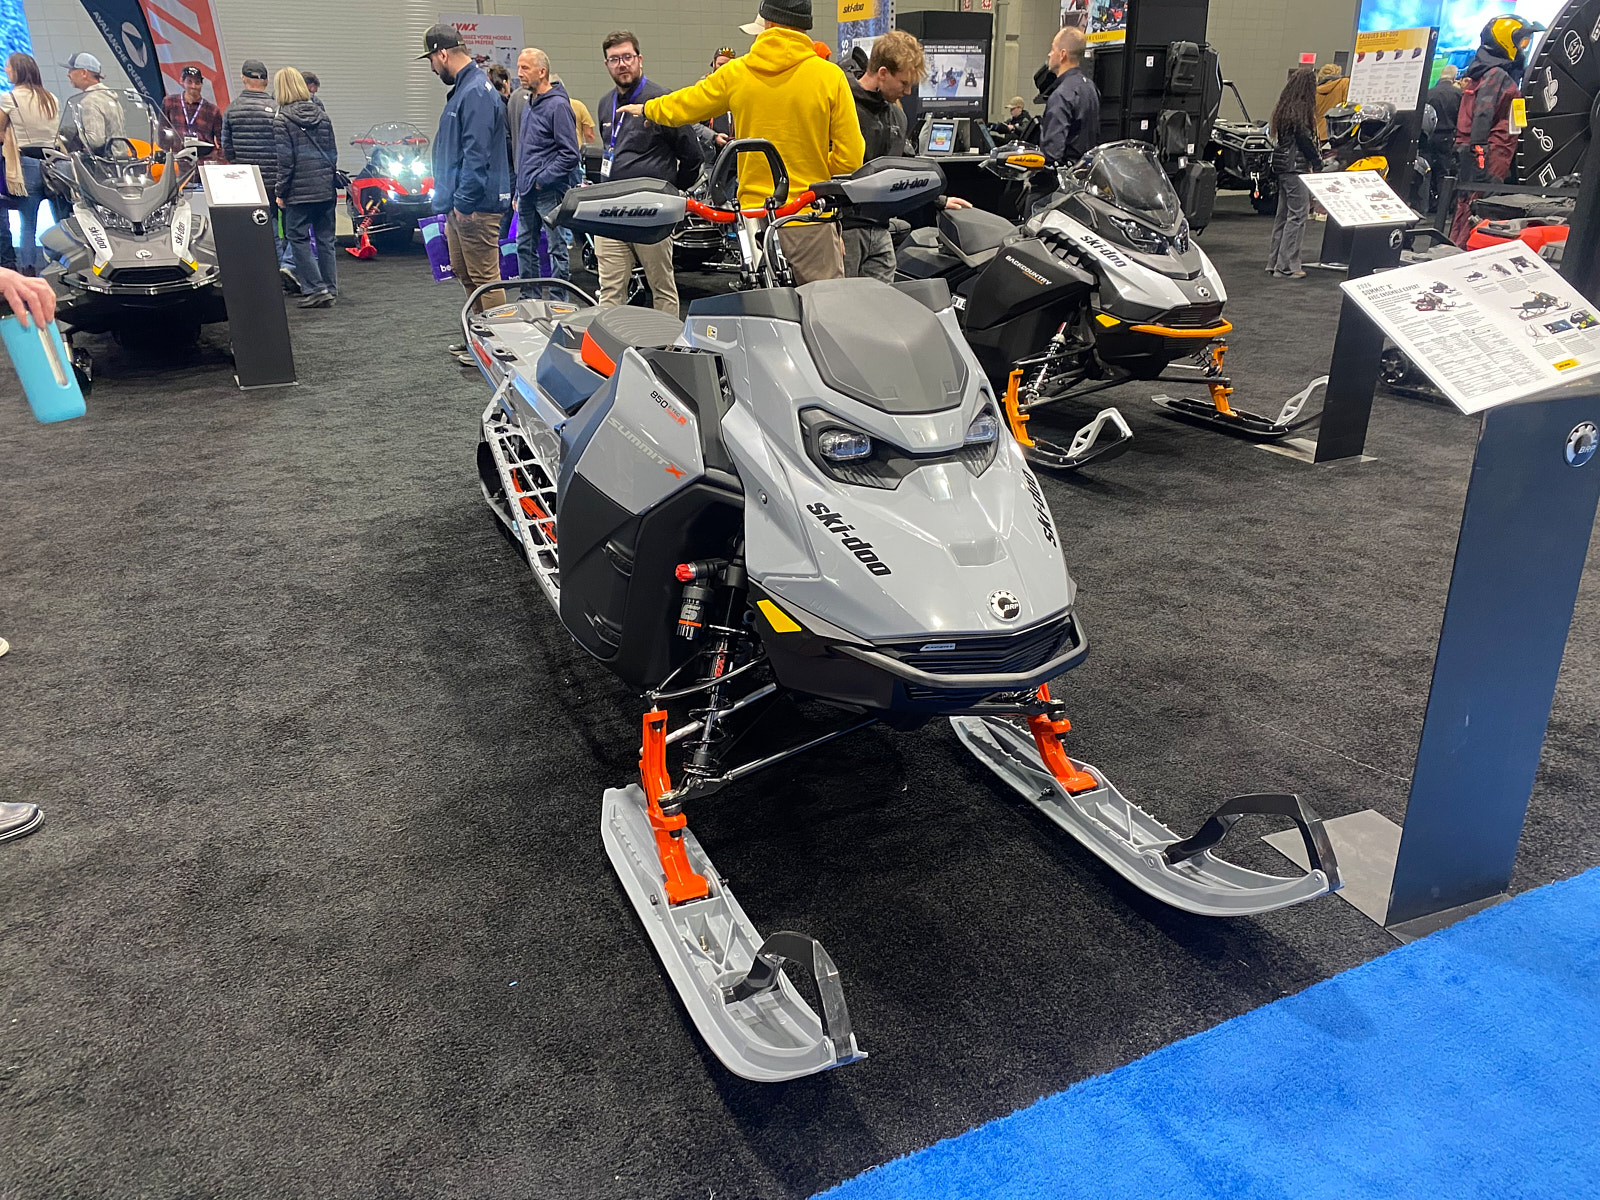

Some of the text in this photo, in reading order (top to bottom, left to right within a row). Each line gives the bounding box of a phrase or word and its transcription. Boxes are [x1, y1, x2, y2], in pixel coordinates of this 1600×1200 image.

[92, 11, 127, 63] AVALANCHE
[451, 23, 478, 31] YNX
[890, 178, 929, 193] ski-doo
[599, 206, 658, 217] ski-doo
[89, 227, 107, 249] ski-doo
[175, 222, 187, 246] ski-doo
[1080, 235, 1128, 268] ski-doo
[1005, 255, 1053, 286] BACKCOUNTRY
[650, 390, 669, 409] 850
[607, 417, 670, 465] SUMMIT
[1578, 445, 1596, 454] BRP
[1022, 468, 1057, 548] ski-doo
[806, 502, 892, 576] ski-doo
[1004, 603, 1019, 611] BRP
